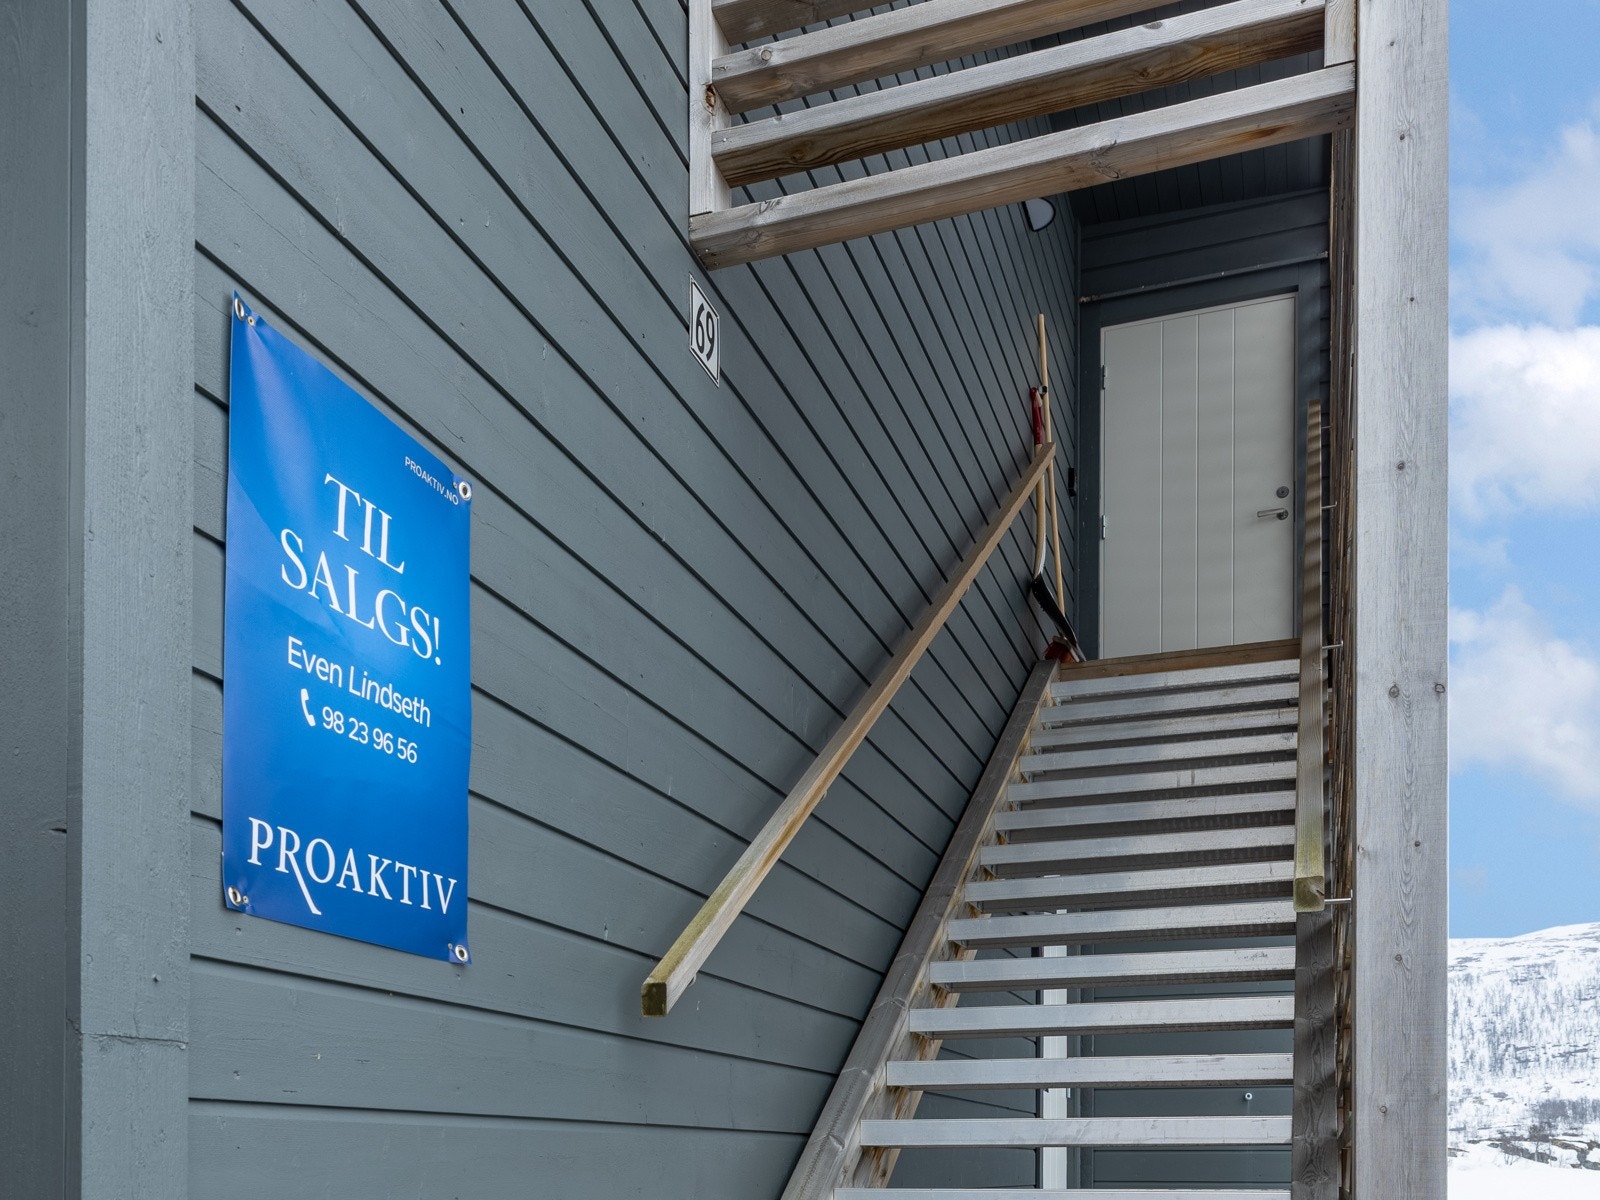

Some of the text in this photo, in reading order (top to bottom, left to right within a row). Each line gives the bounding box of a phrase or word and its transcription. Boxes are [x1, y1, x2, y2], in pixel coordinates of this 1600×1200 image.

[696, 303, 715, 362] 69
[324, 473, 405, 574] TIL
[404, 456, 459, 505] PROAKTIV.NO
[280, 528, 442, 666] SALGS!
[288, 636, 431, 727] Even Lindseth
[322, 706, 418, 764] 98 23 96 56
[247, 816, 457, 915] PROAKTIV
